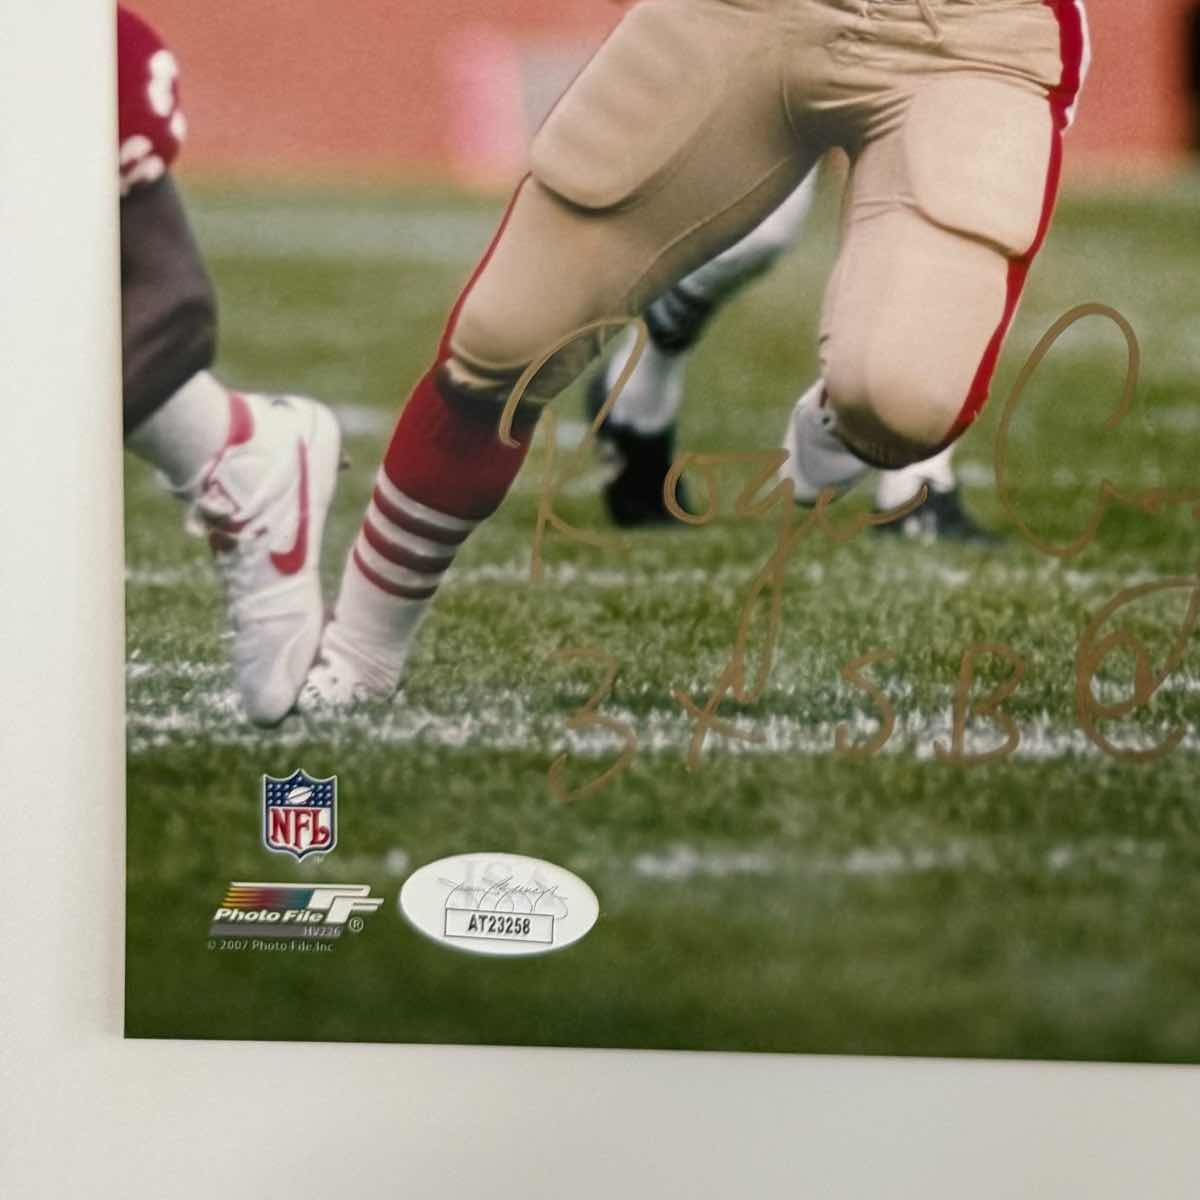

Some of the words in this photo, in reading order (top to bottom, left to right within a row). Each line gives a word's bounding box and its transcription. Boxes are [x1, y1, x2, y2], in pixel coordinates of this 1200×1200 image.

[270, 808, 331, 849] NFL
[214, 908, 280, 922] Photo
[282, 909, 323, 922] File
[468, 914, 531, 935] AT23258
[220, 940, 248, 950] 2007
[252, 940, 287, 951] Photo
